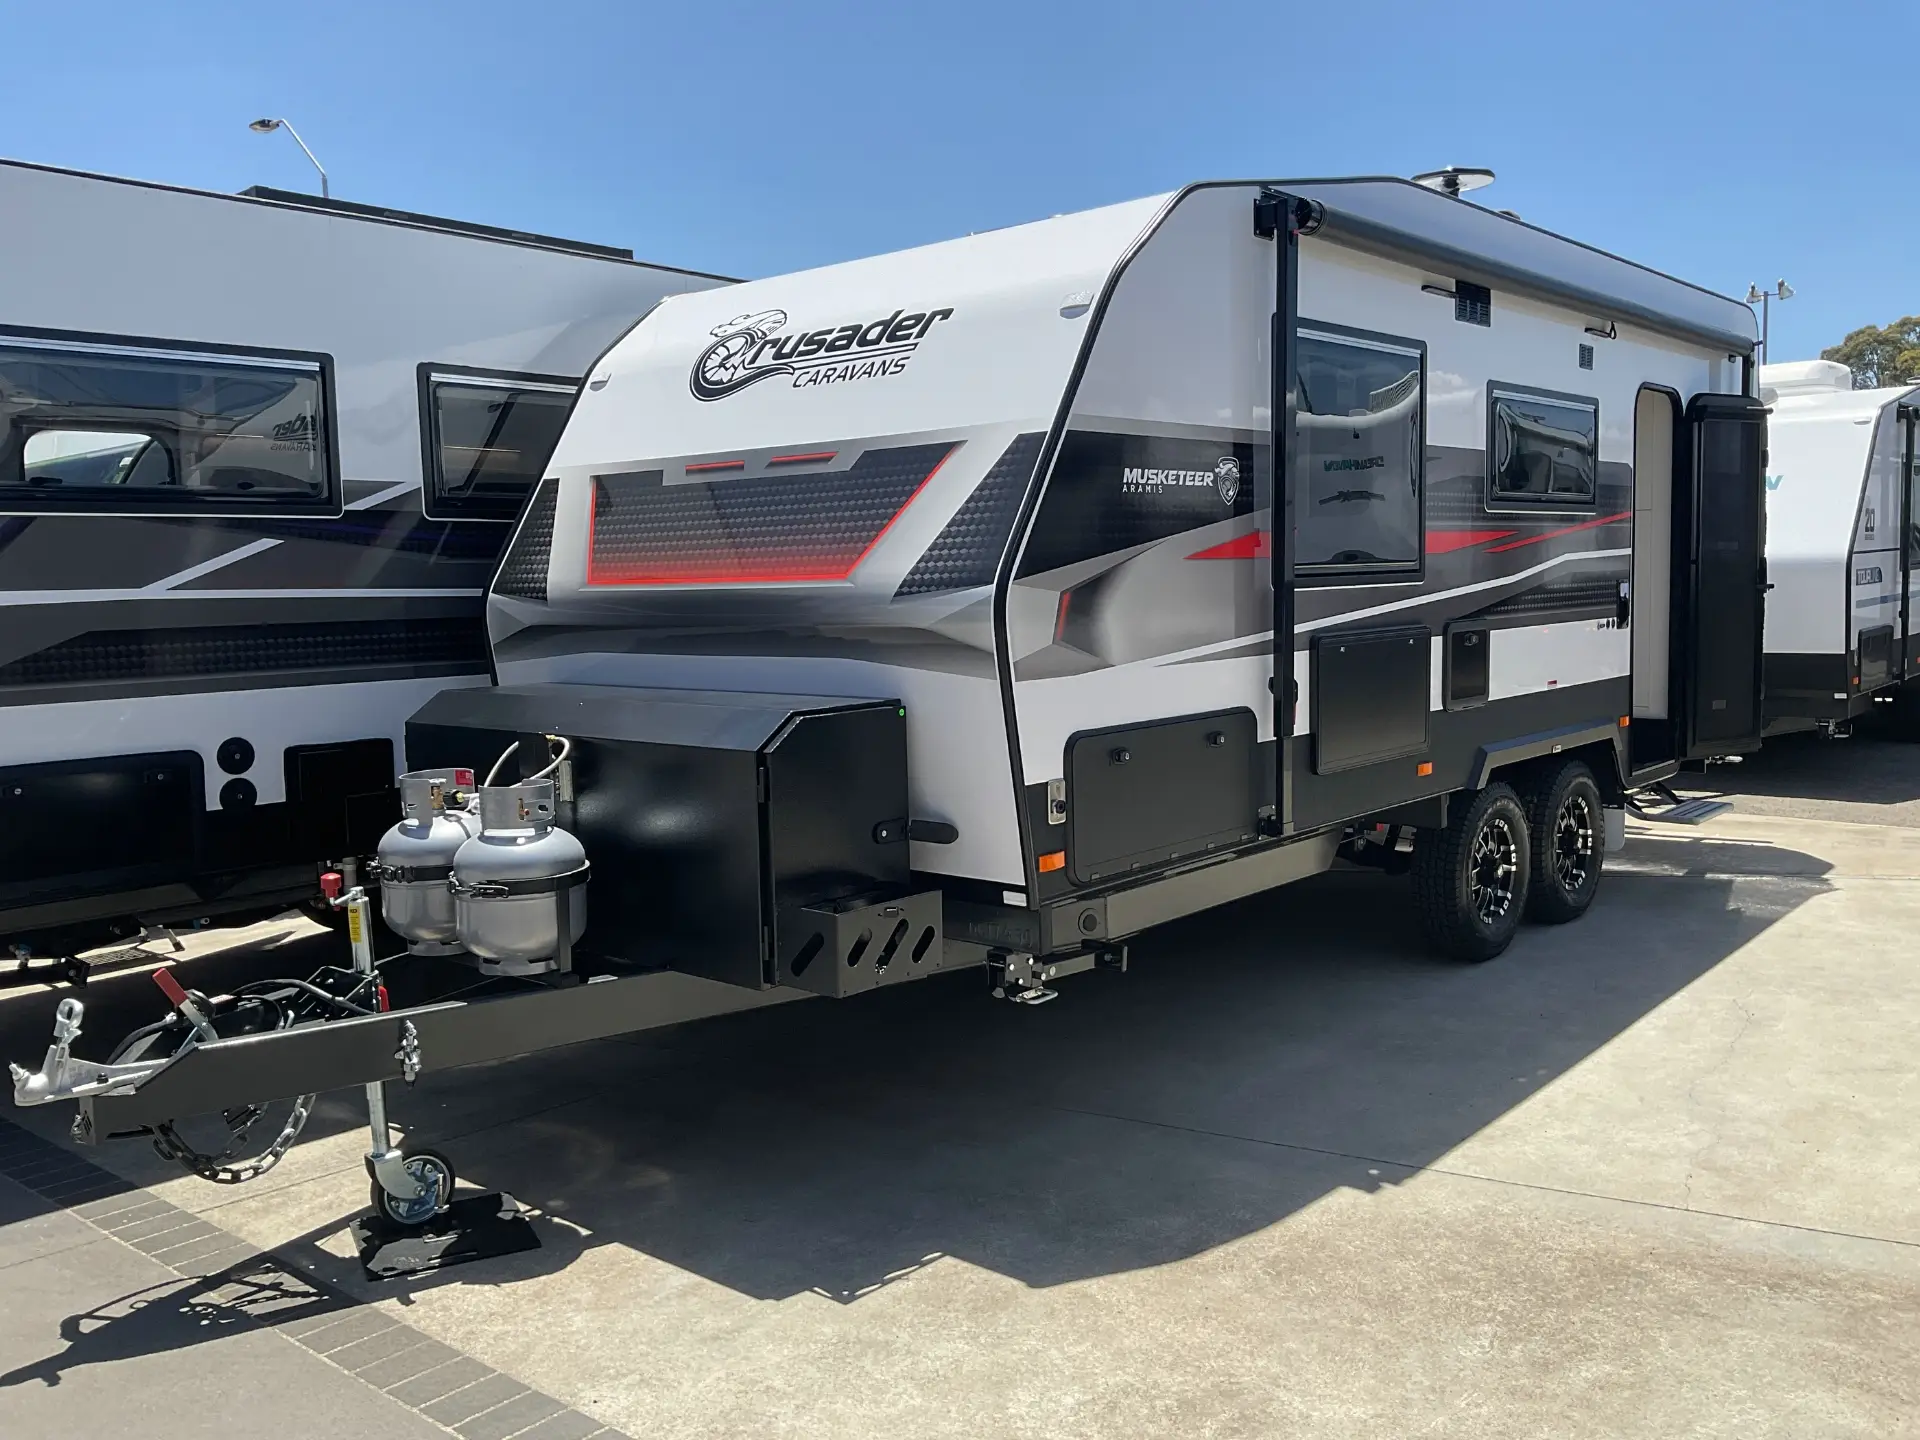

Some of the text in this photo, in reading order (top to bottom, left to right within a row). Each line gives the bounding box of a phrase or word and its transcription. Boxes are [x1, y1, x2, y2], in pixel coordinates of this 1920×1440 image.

[792, 356, 911, 389] CARAVANS
[1123, 467, 1214, 487] MUSKETEER
[1122, 484, 1163, 494] ARAMIS
